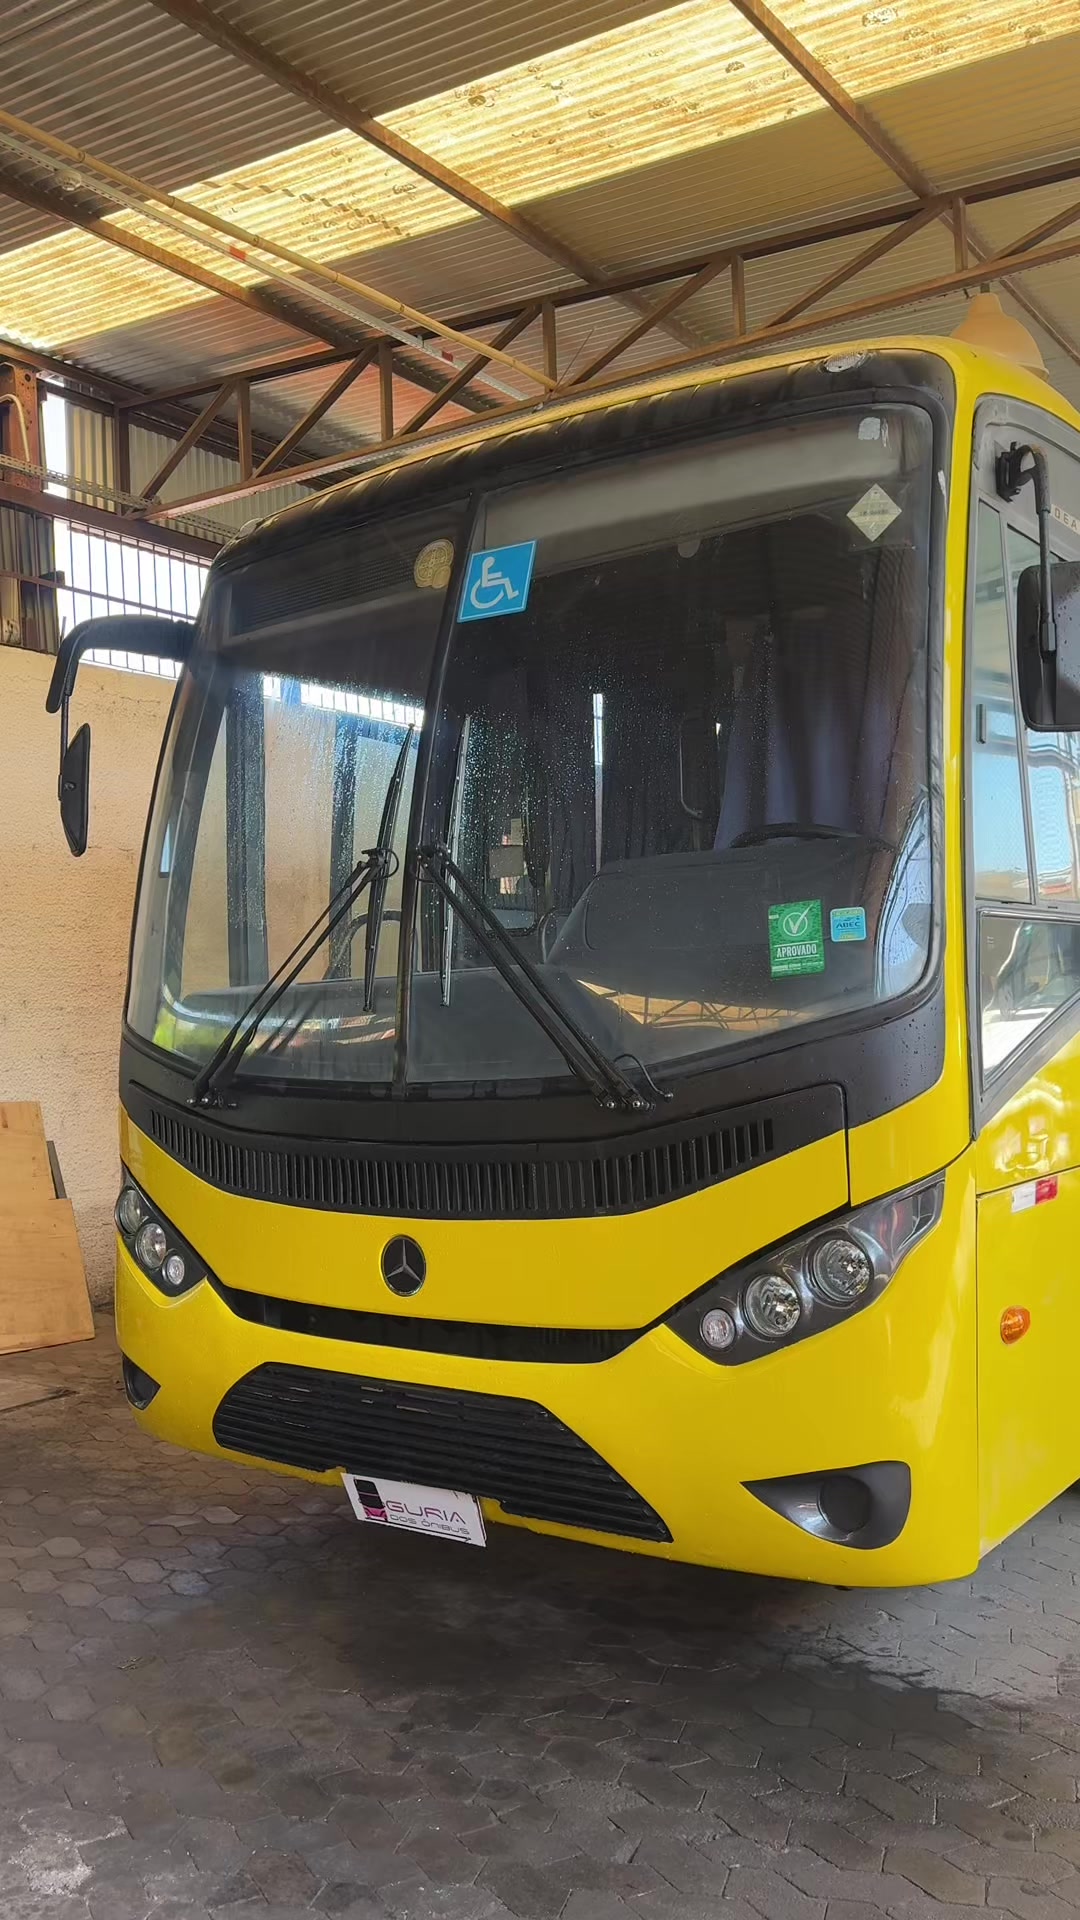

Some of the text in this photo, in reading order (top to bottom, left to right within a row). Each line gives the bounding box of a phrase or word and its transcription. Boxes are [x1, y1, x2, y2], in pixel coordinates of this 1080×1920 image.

[776, 943, 818, 958] APROVADO
[386, 1500, 466, 1525] GURIA
[390, 1514, 417, 1525] DOS
